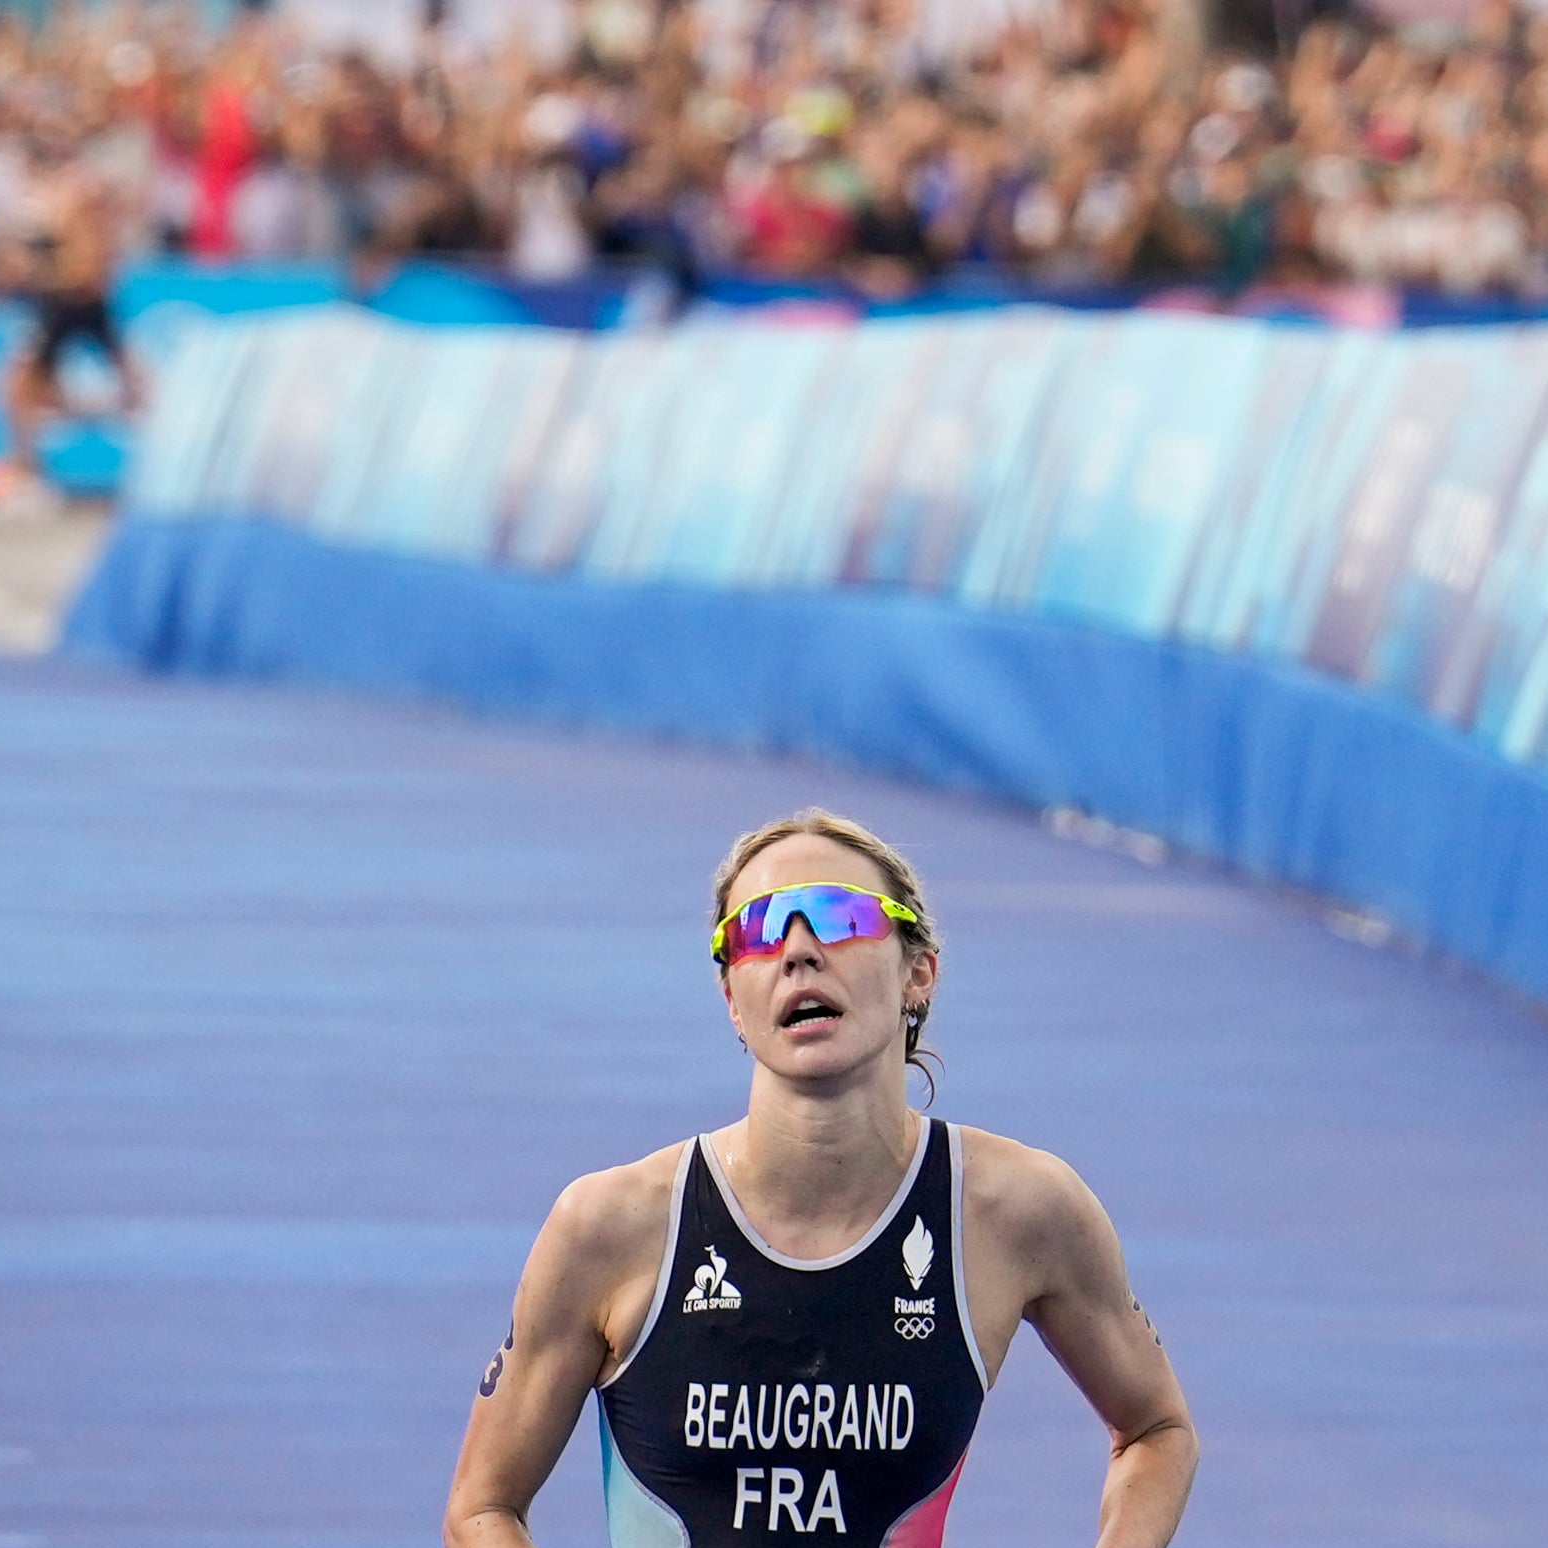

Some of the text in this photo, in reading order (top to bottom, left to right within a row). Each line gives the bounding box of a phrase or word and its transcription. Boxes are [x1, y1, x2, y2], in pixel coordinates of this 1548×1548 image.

[682, 1300, 693, 1314] LE
[709, 1297, 742, 1310] SPORTIF
[894, 1295, 935, 1315] FRANCE
[684, 1382, 915, 1450] BEAUGRAND
[732, 1467, 847, 1534] FRA
